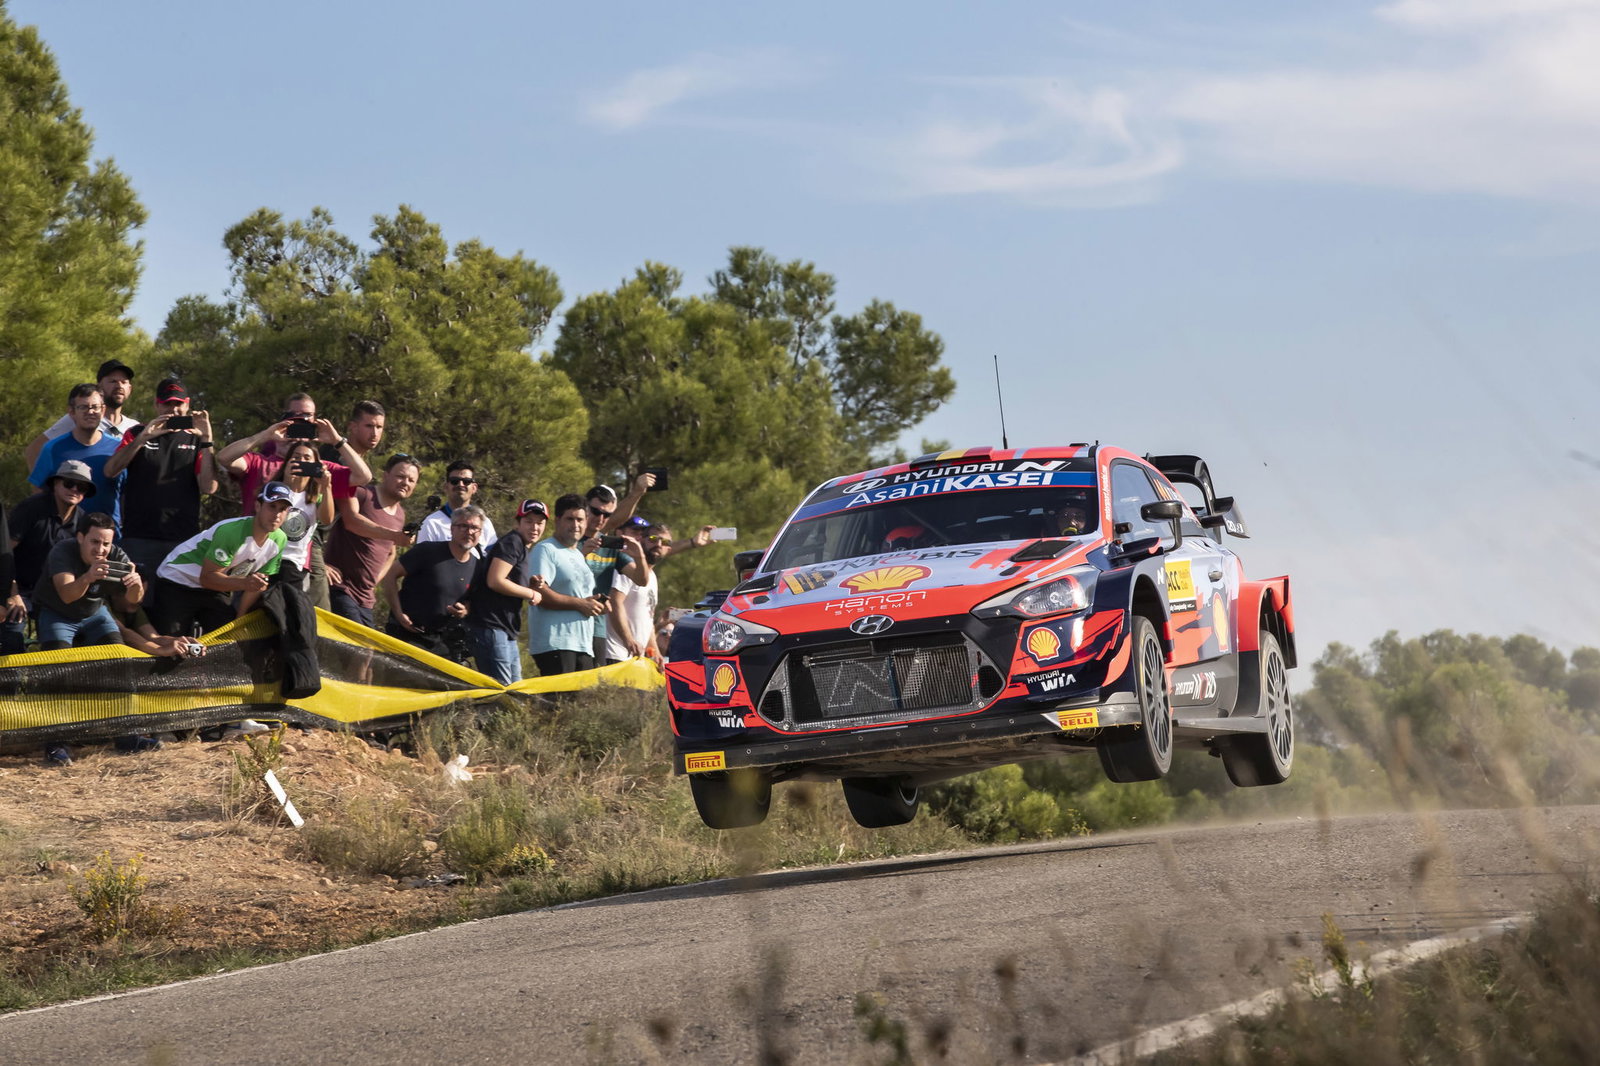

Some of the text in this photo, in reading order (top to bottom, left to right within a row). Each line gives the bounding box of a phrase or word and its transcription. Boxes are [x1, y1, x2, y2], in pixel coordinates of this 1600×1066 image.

[893, 462, 1004, 484] HYUNDAI
[845, 472, 1054, 509] AsahiKASEI
[1165, 570, 1181, 592] ACC
[824, 591, 926, 611] Hanon
[834, 601, 913, 616] SYSTEMS
[1026, 669, 1060, 684] HYUNDAI
[687, 755, 721, 769] PIRELLI
